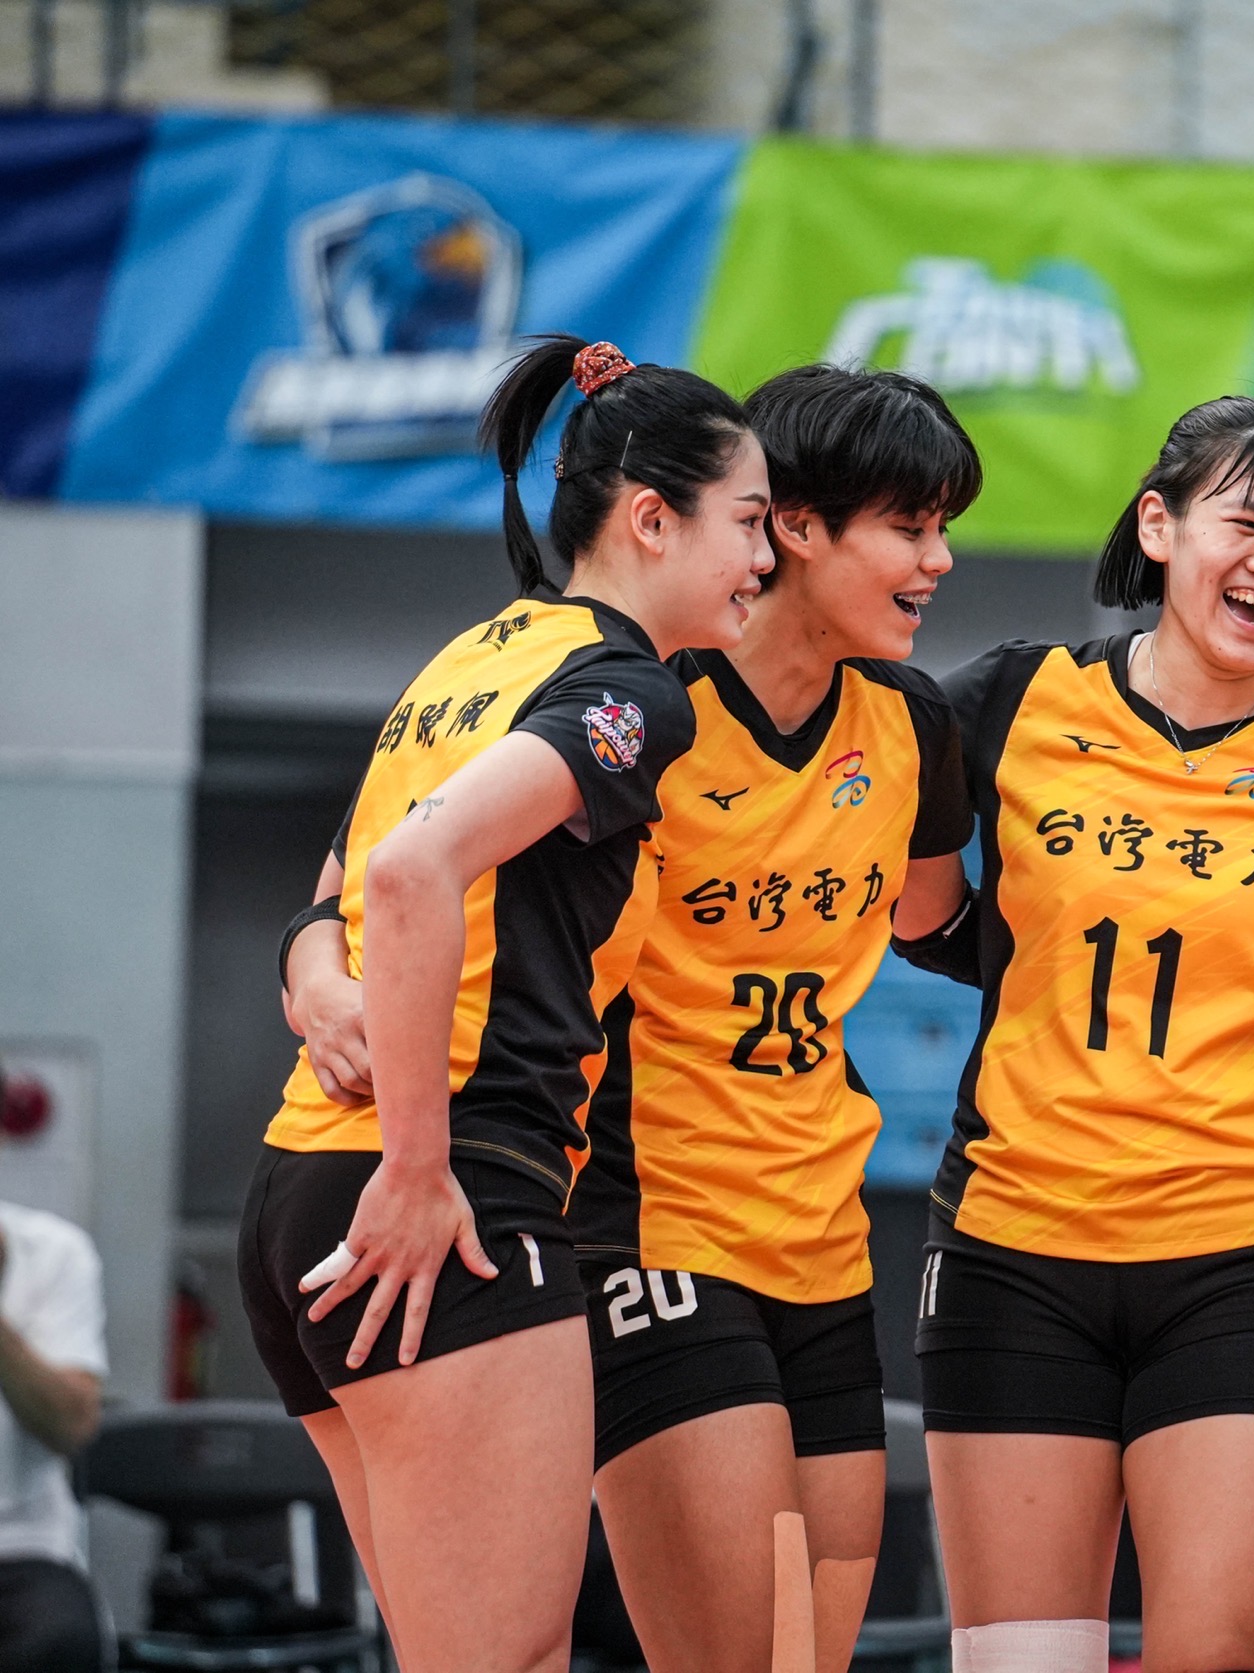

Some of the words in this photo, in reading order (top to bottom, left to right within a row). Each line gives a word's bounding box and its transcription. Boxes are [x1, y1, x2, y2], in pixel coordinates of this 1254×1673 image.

[585, 708, 636, 766] Taipower
[681, 862, 884, 932] 台灣電力
[1083, 916, 1183, 1060] 11
[728, 972, 829, 1077] 20
[518, 1232, 545, 1288] 1
[603, 1267, 698, 1339] 20
